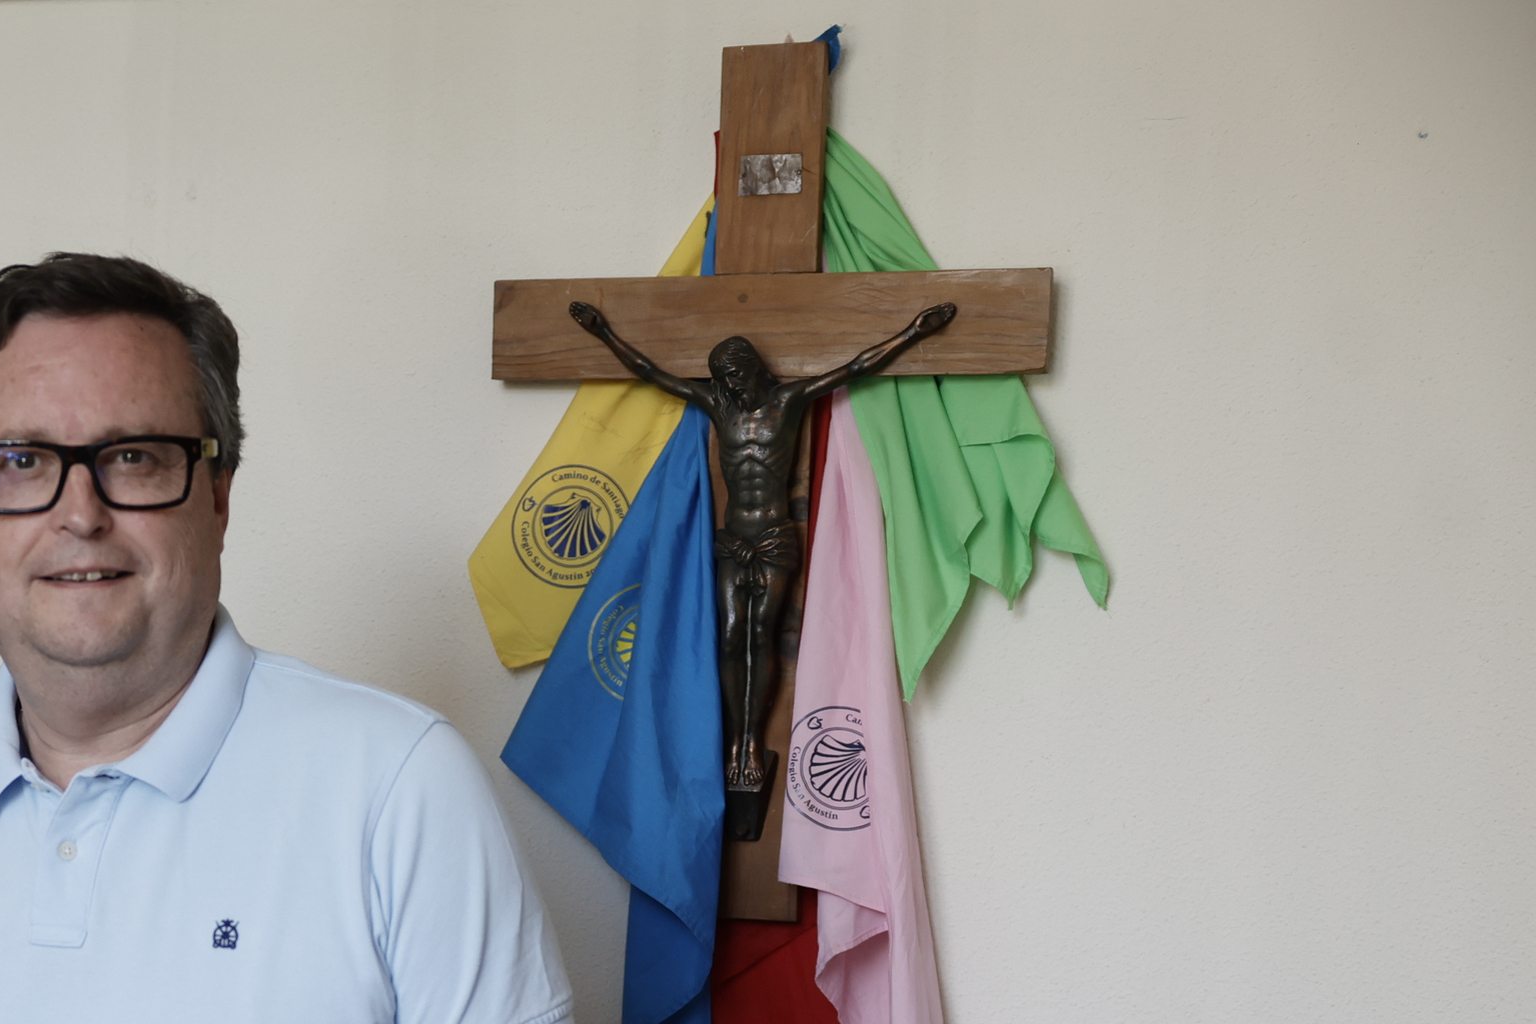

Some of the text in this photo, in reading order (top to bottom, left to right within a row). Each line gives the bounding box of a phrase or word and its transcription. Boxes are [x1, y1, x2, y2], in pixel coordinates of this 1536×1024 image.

[551, 470, 625, 519] Camino de Santiago
[520, 520, 533, 558] Colegio
[531, 555, 546, 572] San
[788, 746, 802, 783] Colegio
[792, 782, 805, 800] San
